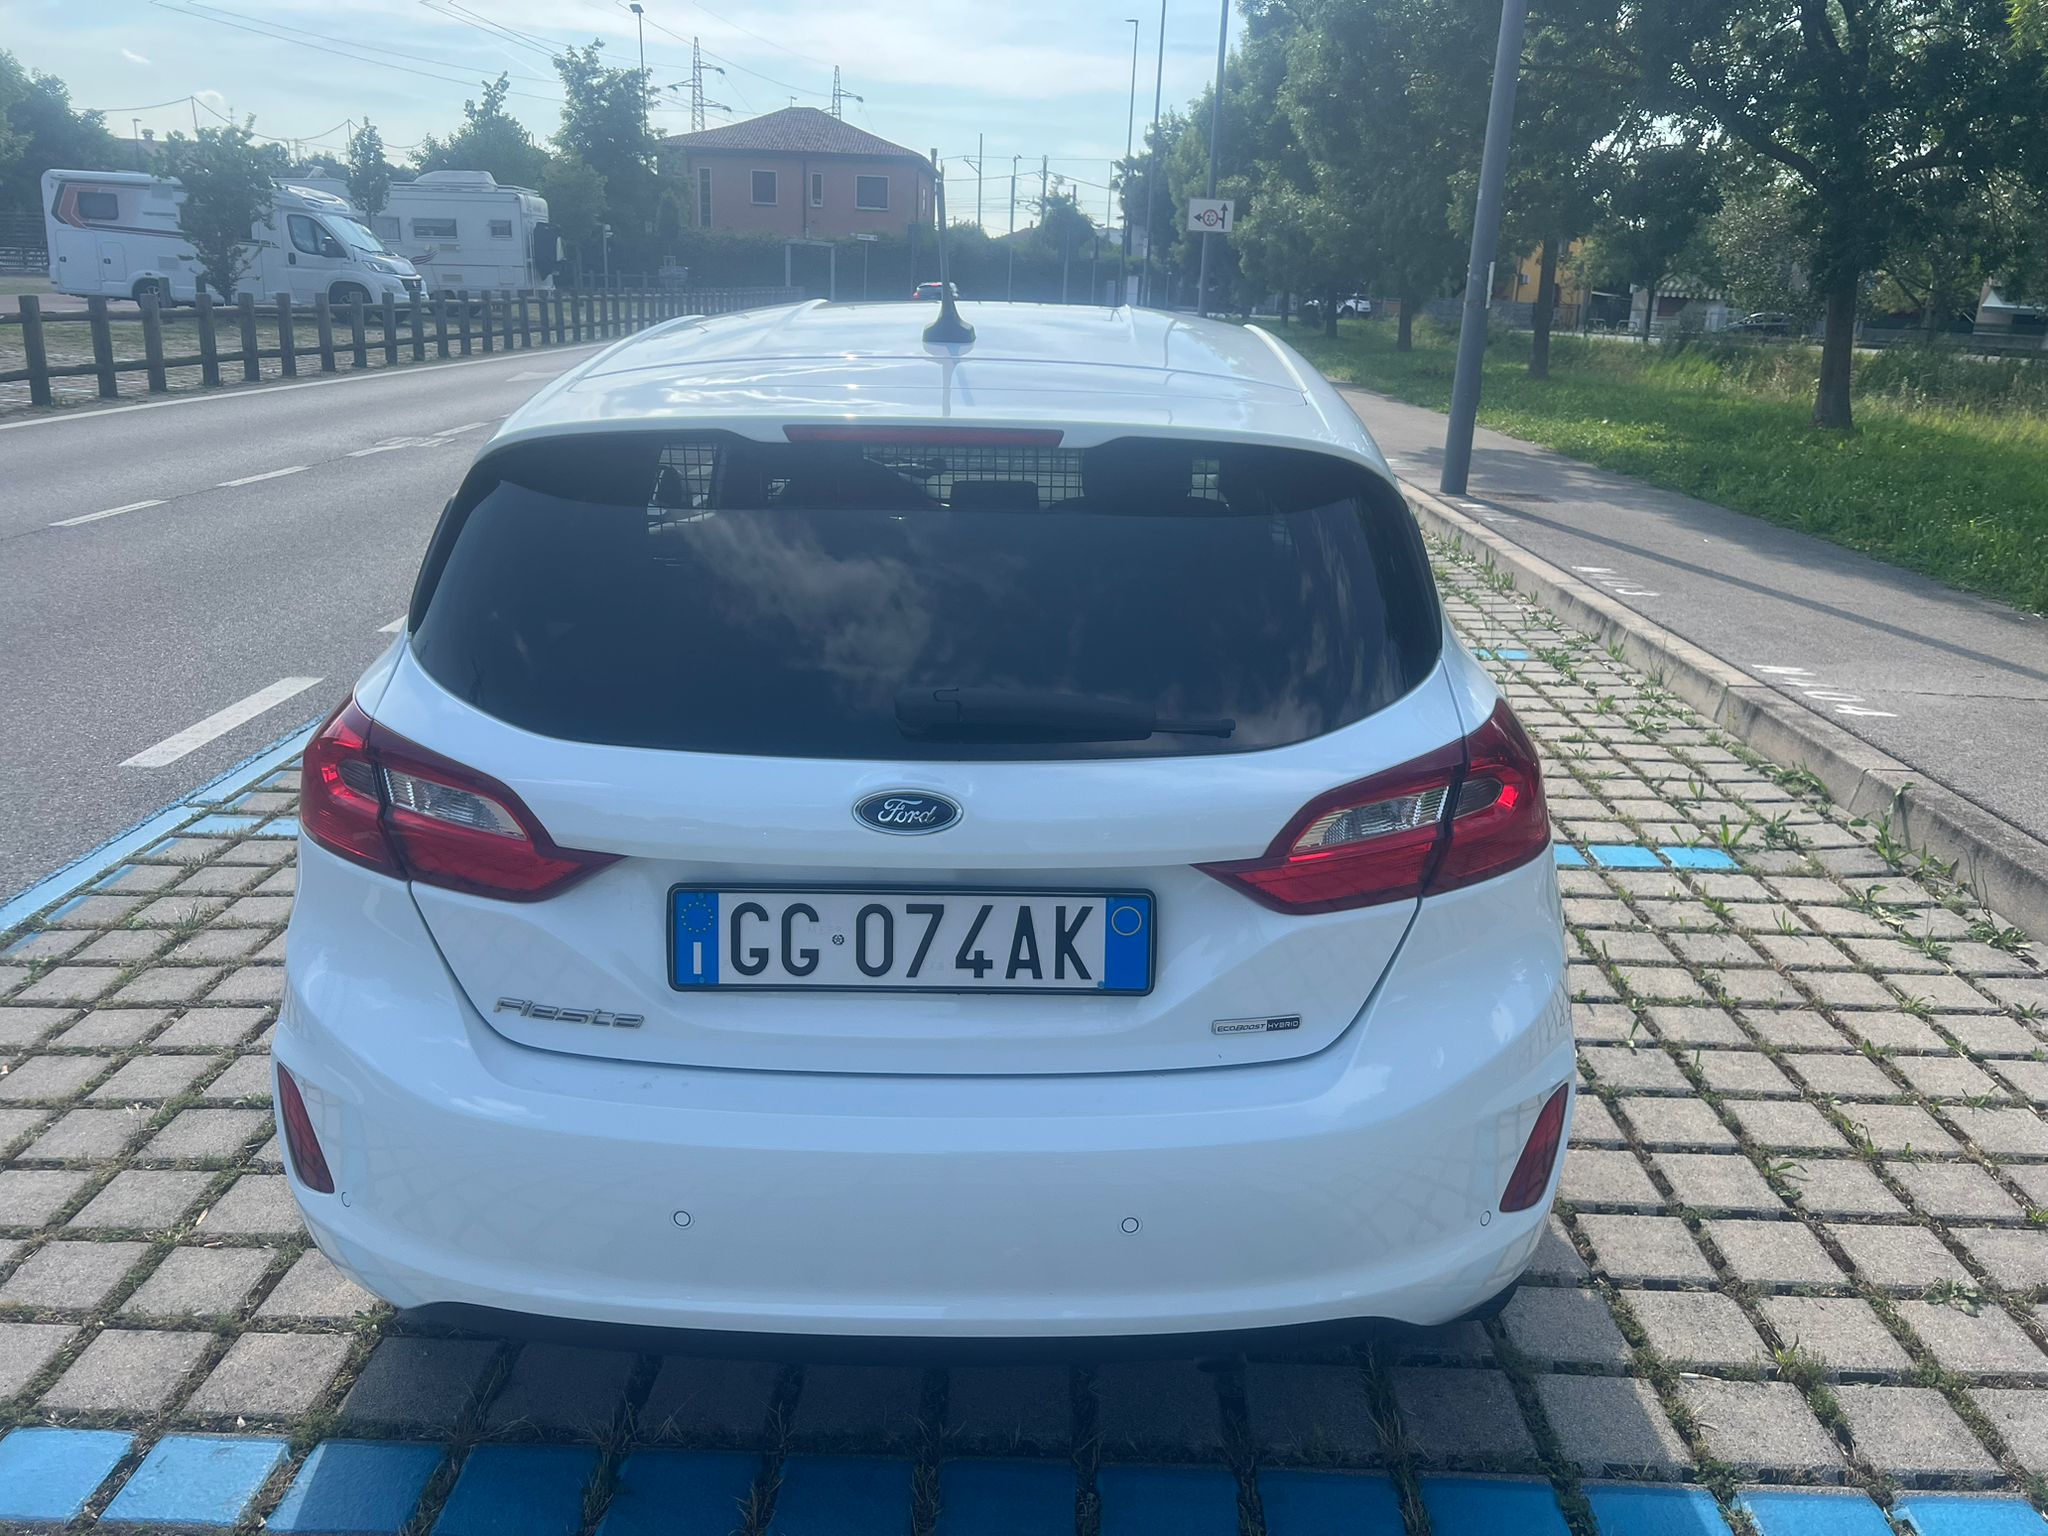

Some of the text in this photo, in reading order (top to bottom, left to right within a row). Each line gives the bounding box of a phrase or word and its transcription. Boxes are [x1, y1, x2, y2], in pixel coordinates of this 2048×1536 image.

[877, 798, 938, 824] Ford
[730, 901, 1093, 980] GG 074AK
[493, 996, 645, 1029] Fiesta
[1267, 1020, 1299, 1030] HYBRID
